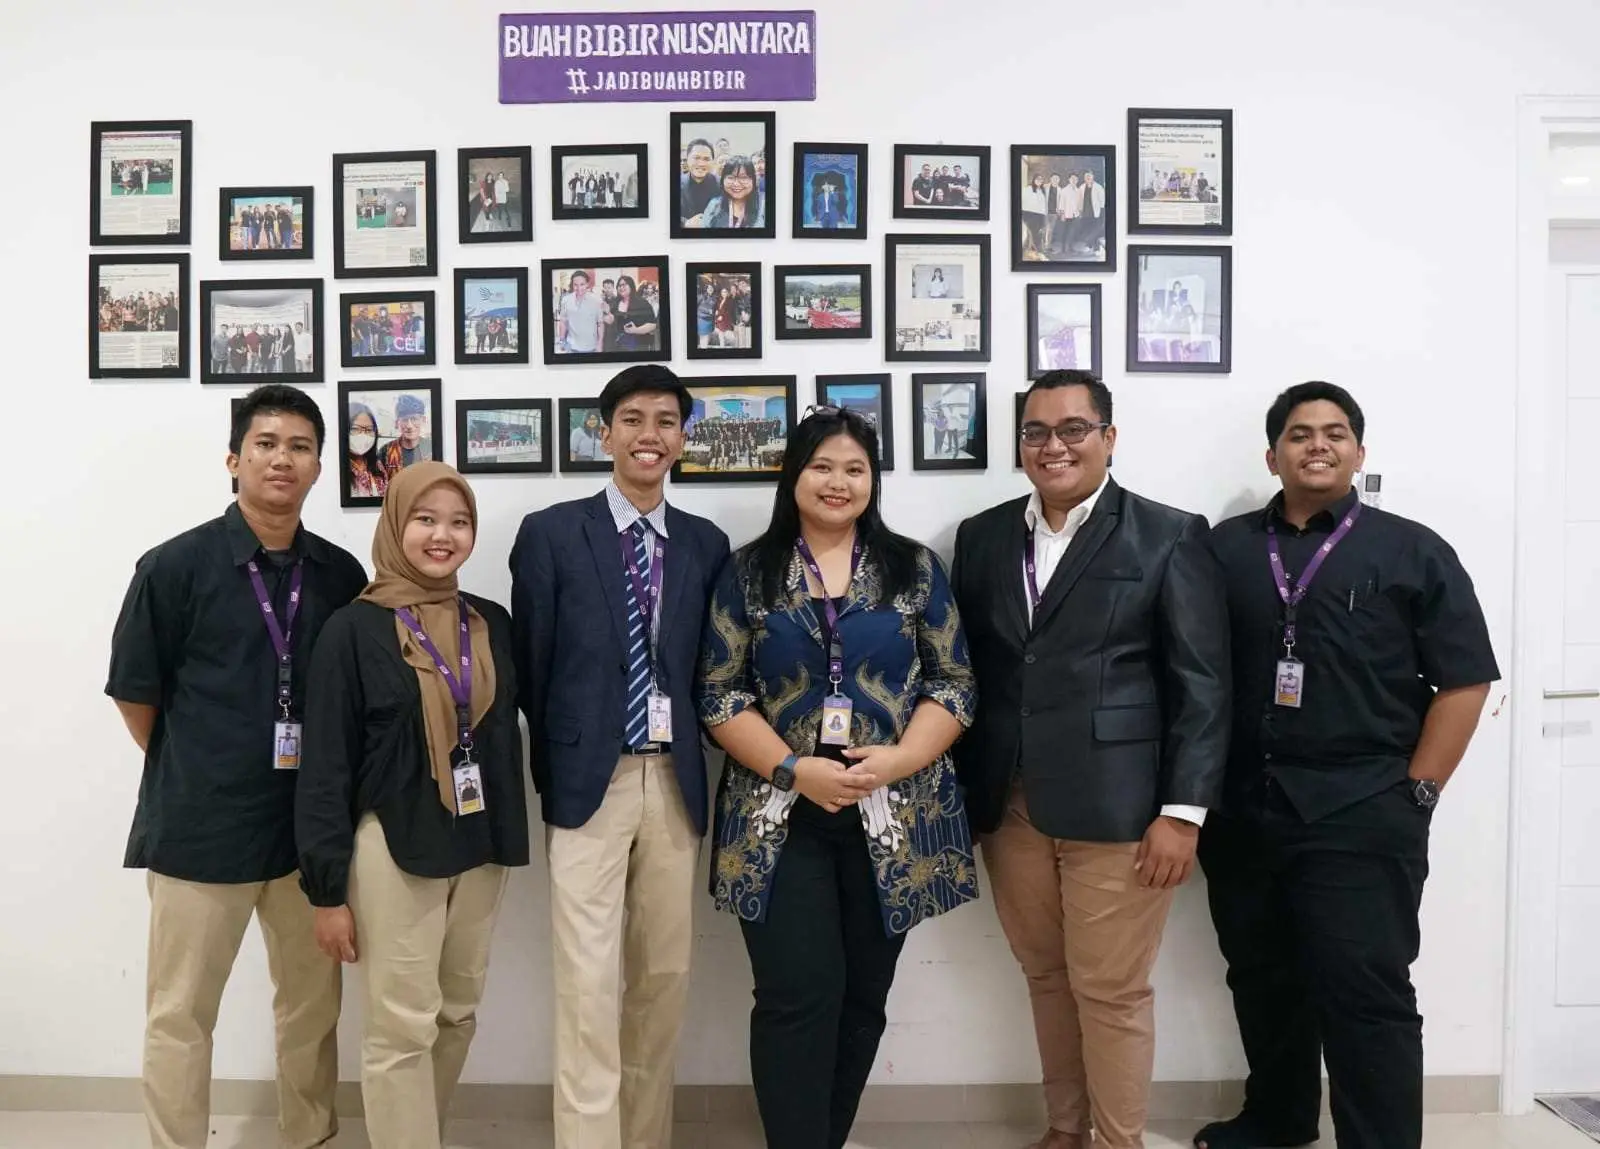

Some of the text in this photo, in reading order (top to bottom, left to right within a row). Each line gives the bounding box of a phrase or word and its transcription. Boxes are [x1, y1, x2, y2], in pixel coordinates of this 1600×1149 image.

[504, 21, 810, 57] BUAH BIBIR NUSANTARA
[566, 68, 746, 94] #JADIBUAHBIBIR
